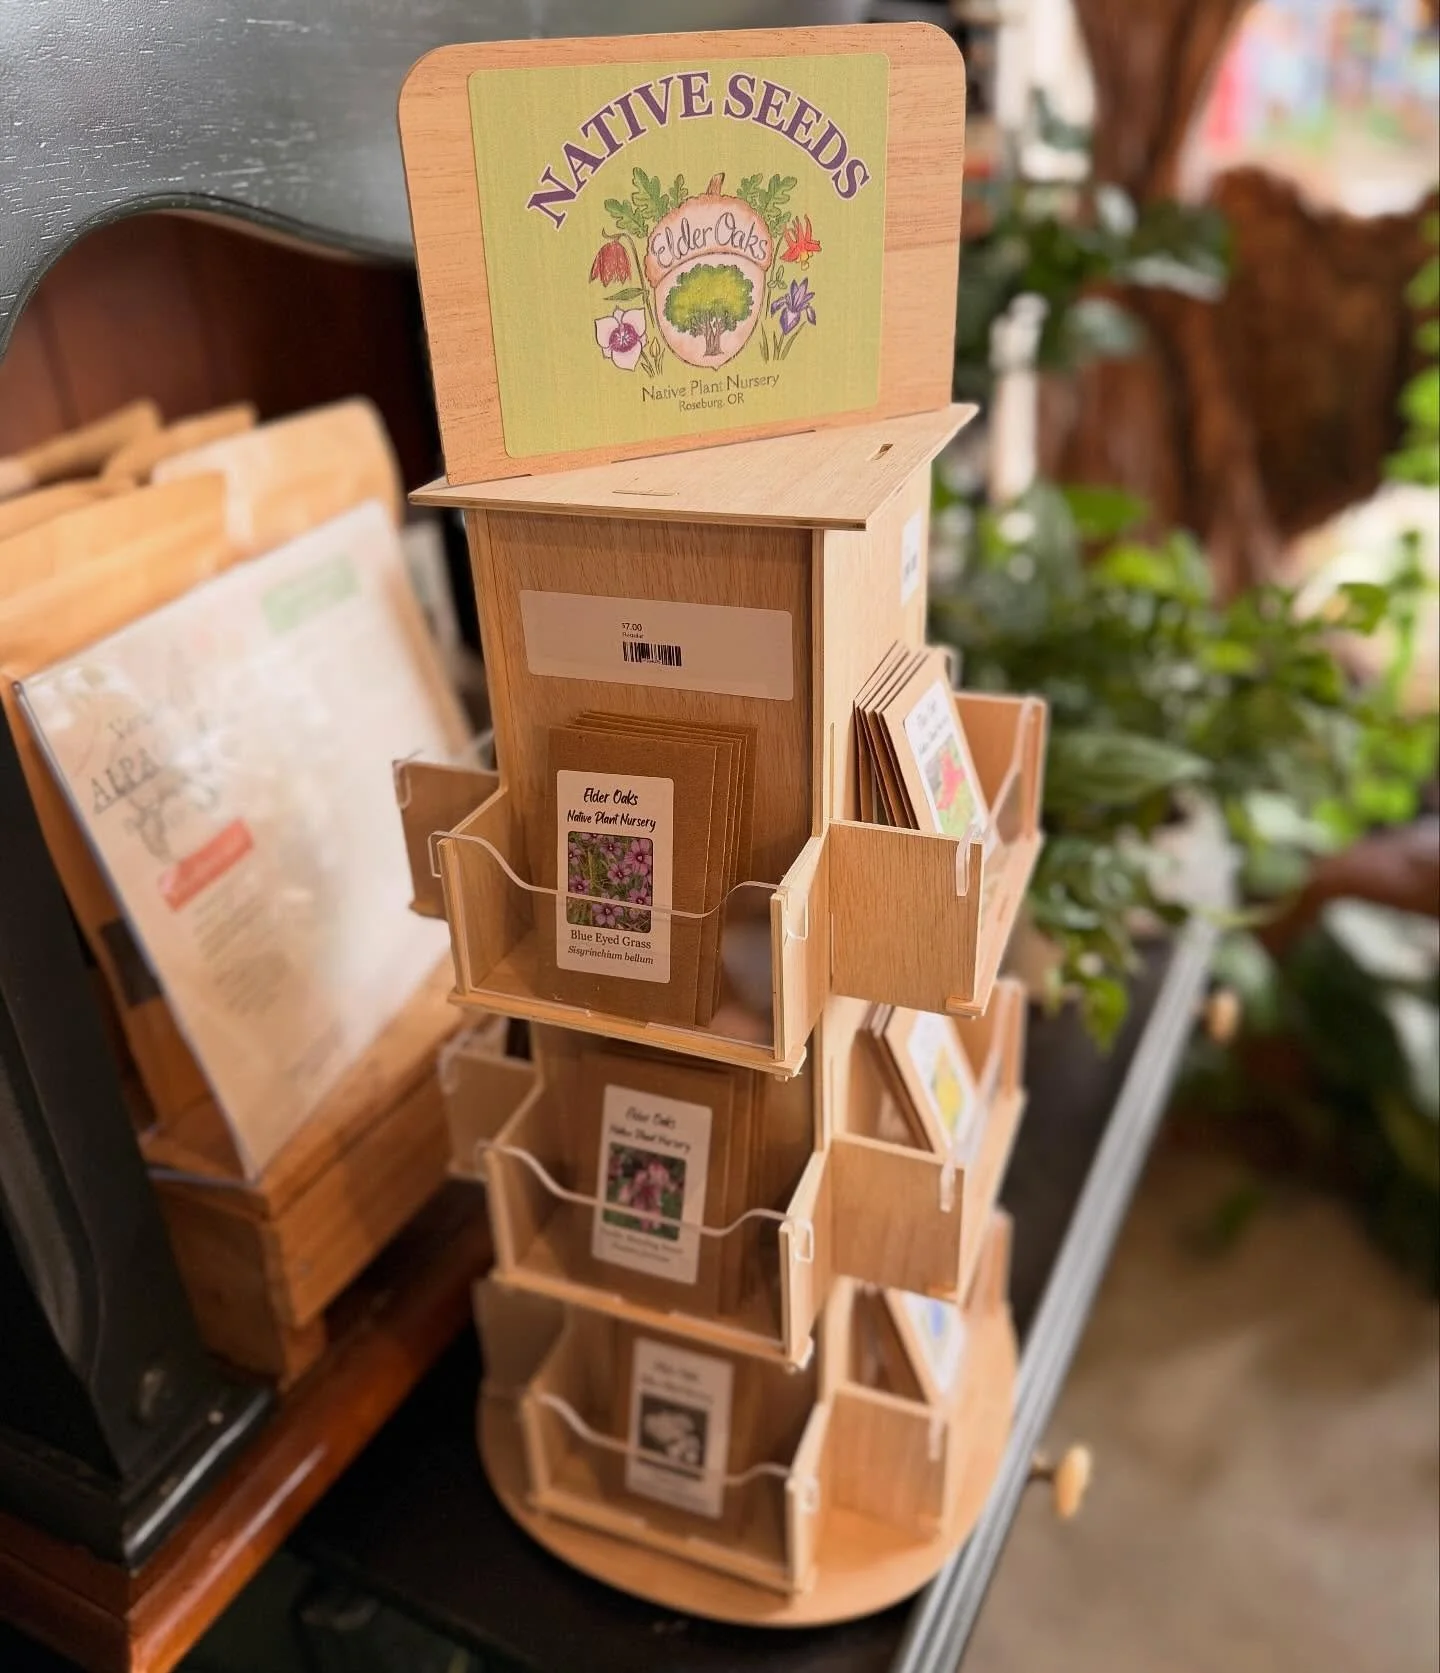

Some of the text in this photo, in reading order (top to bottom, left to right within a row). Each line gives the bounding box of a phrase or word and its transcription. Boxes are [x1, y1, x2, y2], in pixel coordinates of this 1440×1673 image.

[525, 71, 872, 231] NATIVE SEEDS
[650, 212, 768, 268] Elder Oaks
[642, 374, 780, 402] Native Plant Nursery
[727, 392, 745, 405] OR
[621, 622, 643, 631] $7.00
[583, 788, 639, 806] Elder Oaks
[567, 809, 657, 833] Native Plant Nursery
[570, 930, 652, 949] Blue Eyed Grass
[568, 945, 654, 965] Sisyrinchium bellum
